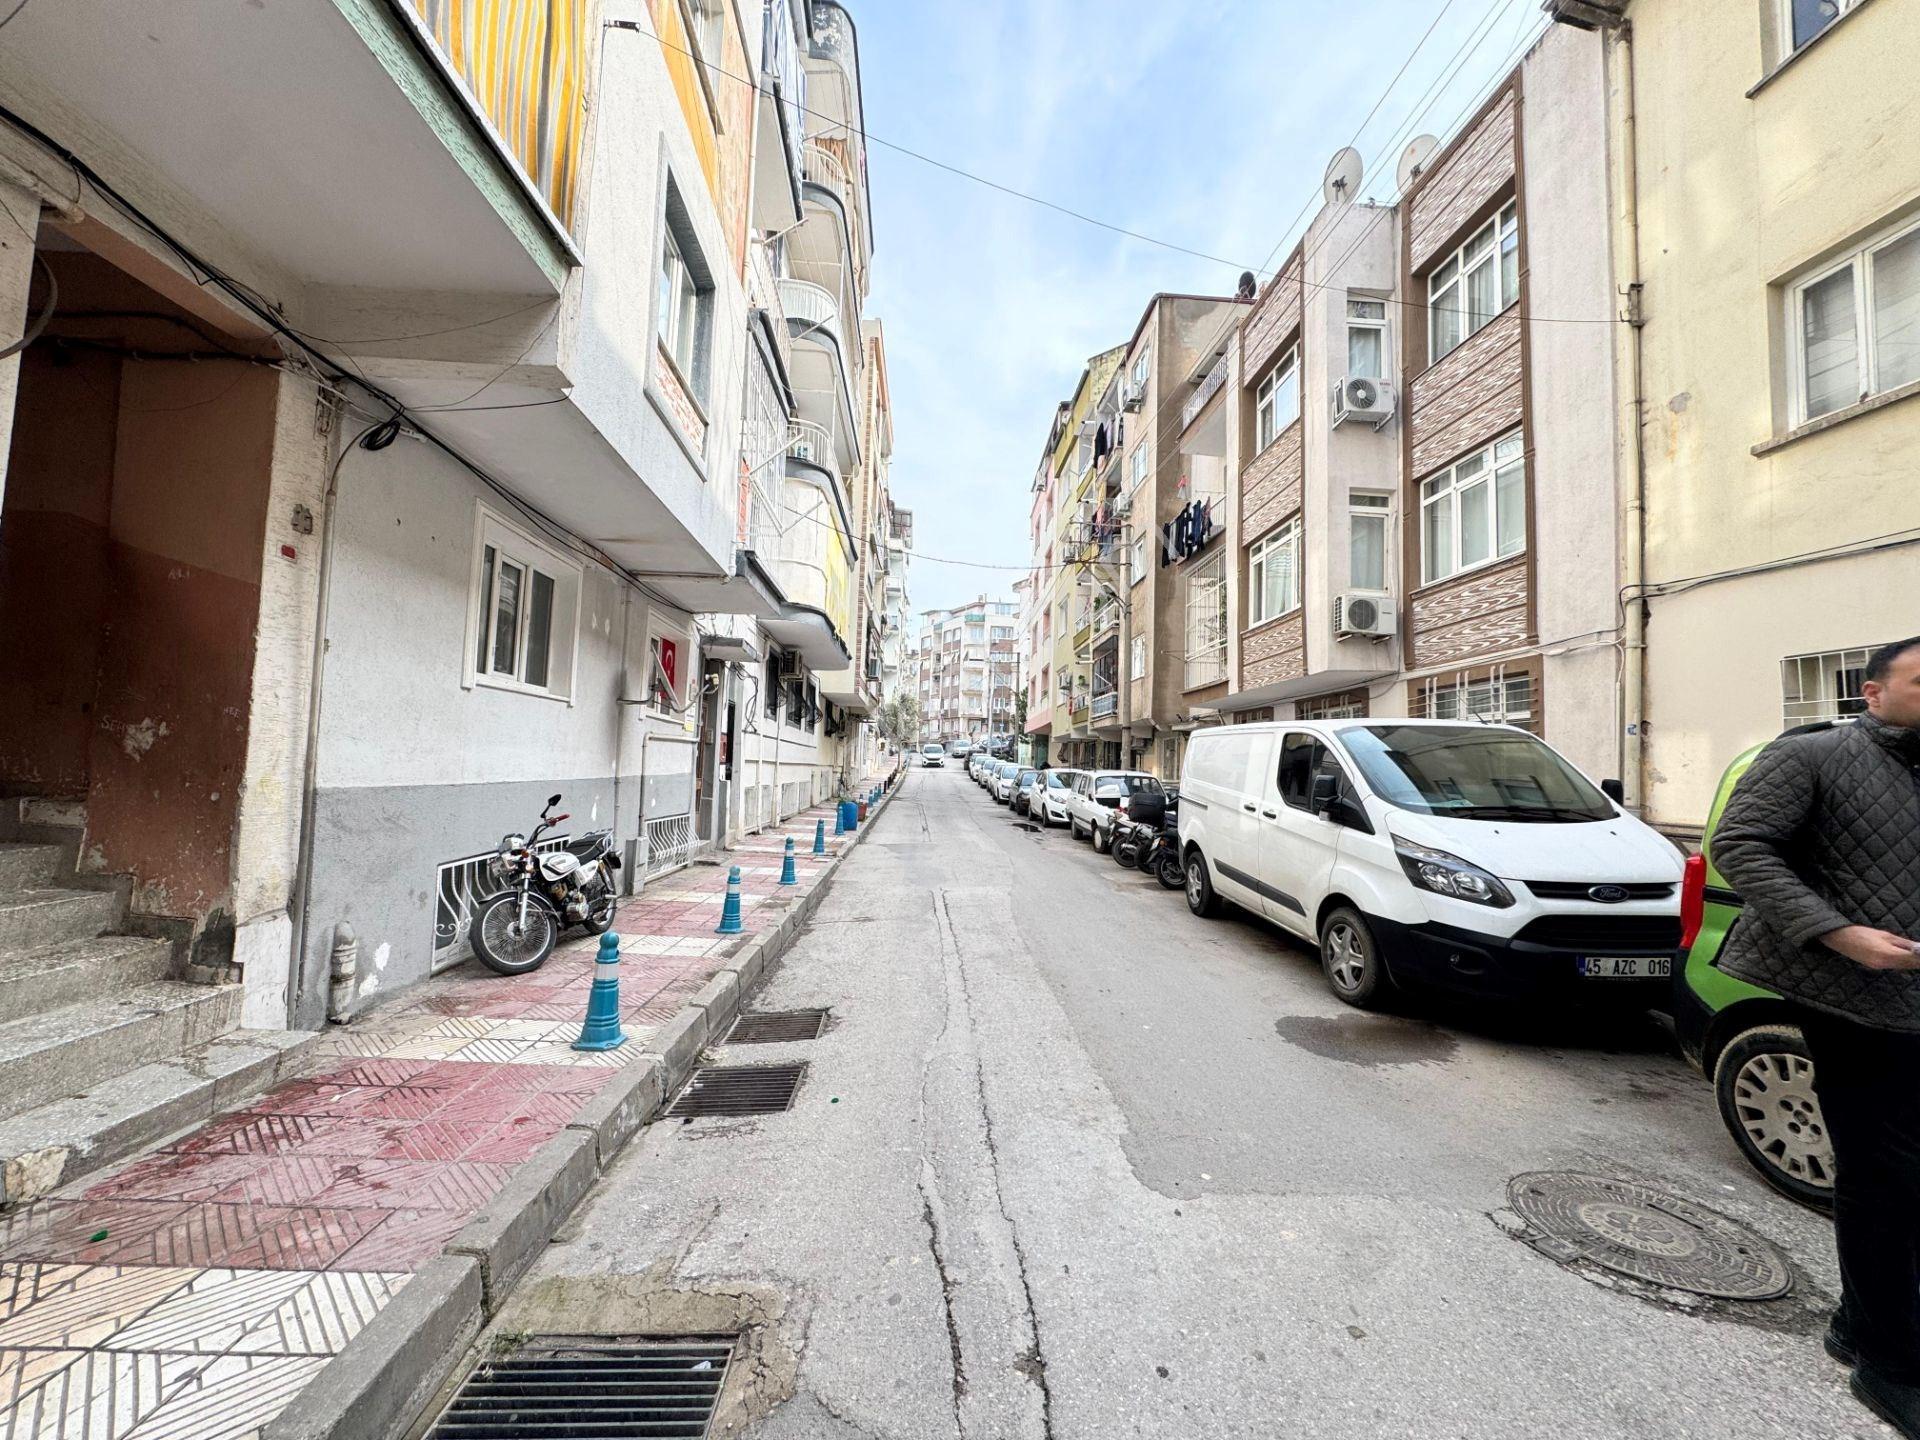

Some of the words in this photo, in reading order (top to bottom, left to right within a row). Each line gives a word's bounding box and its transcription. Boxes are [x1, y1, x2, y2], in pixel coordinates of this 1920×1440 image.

[1586, 959, 1601, 975] 45
[1613, 960, 1637, 975] AZC
[1648, 960, 1670, 975] 016
